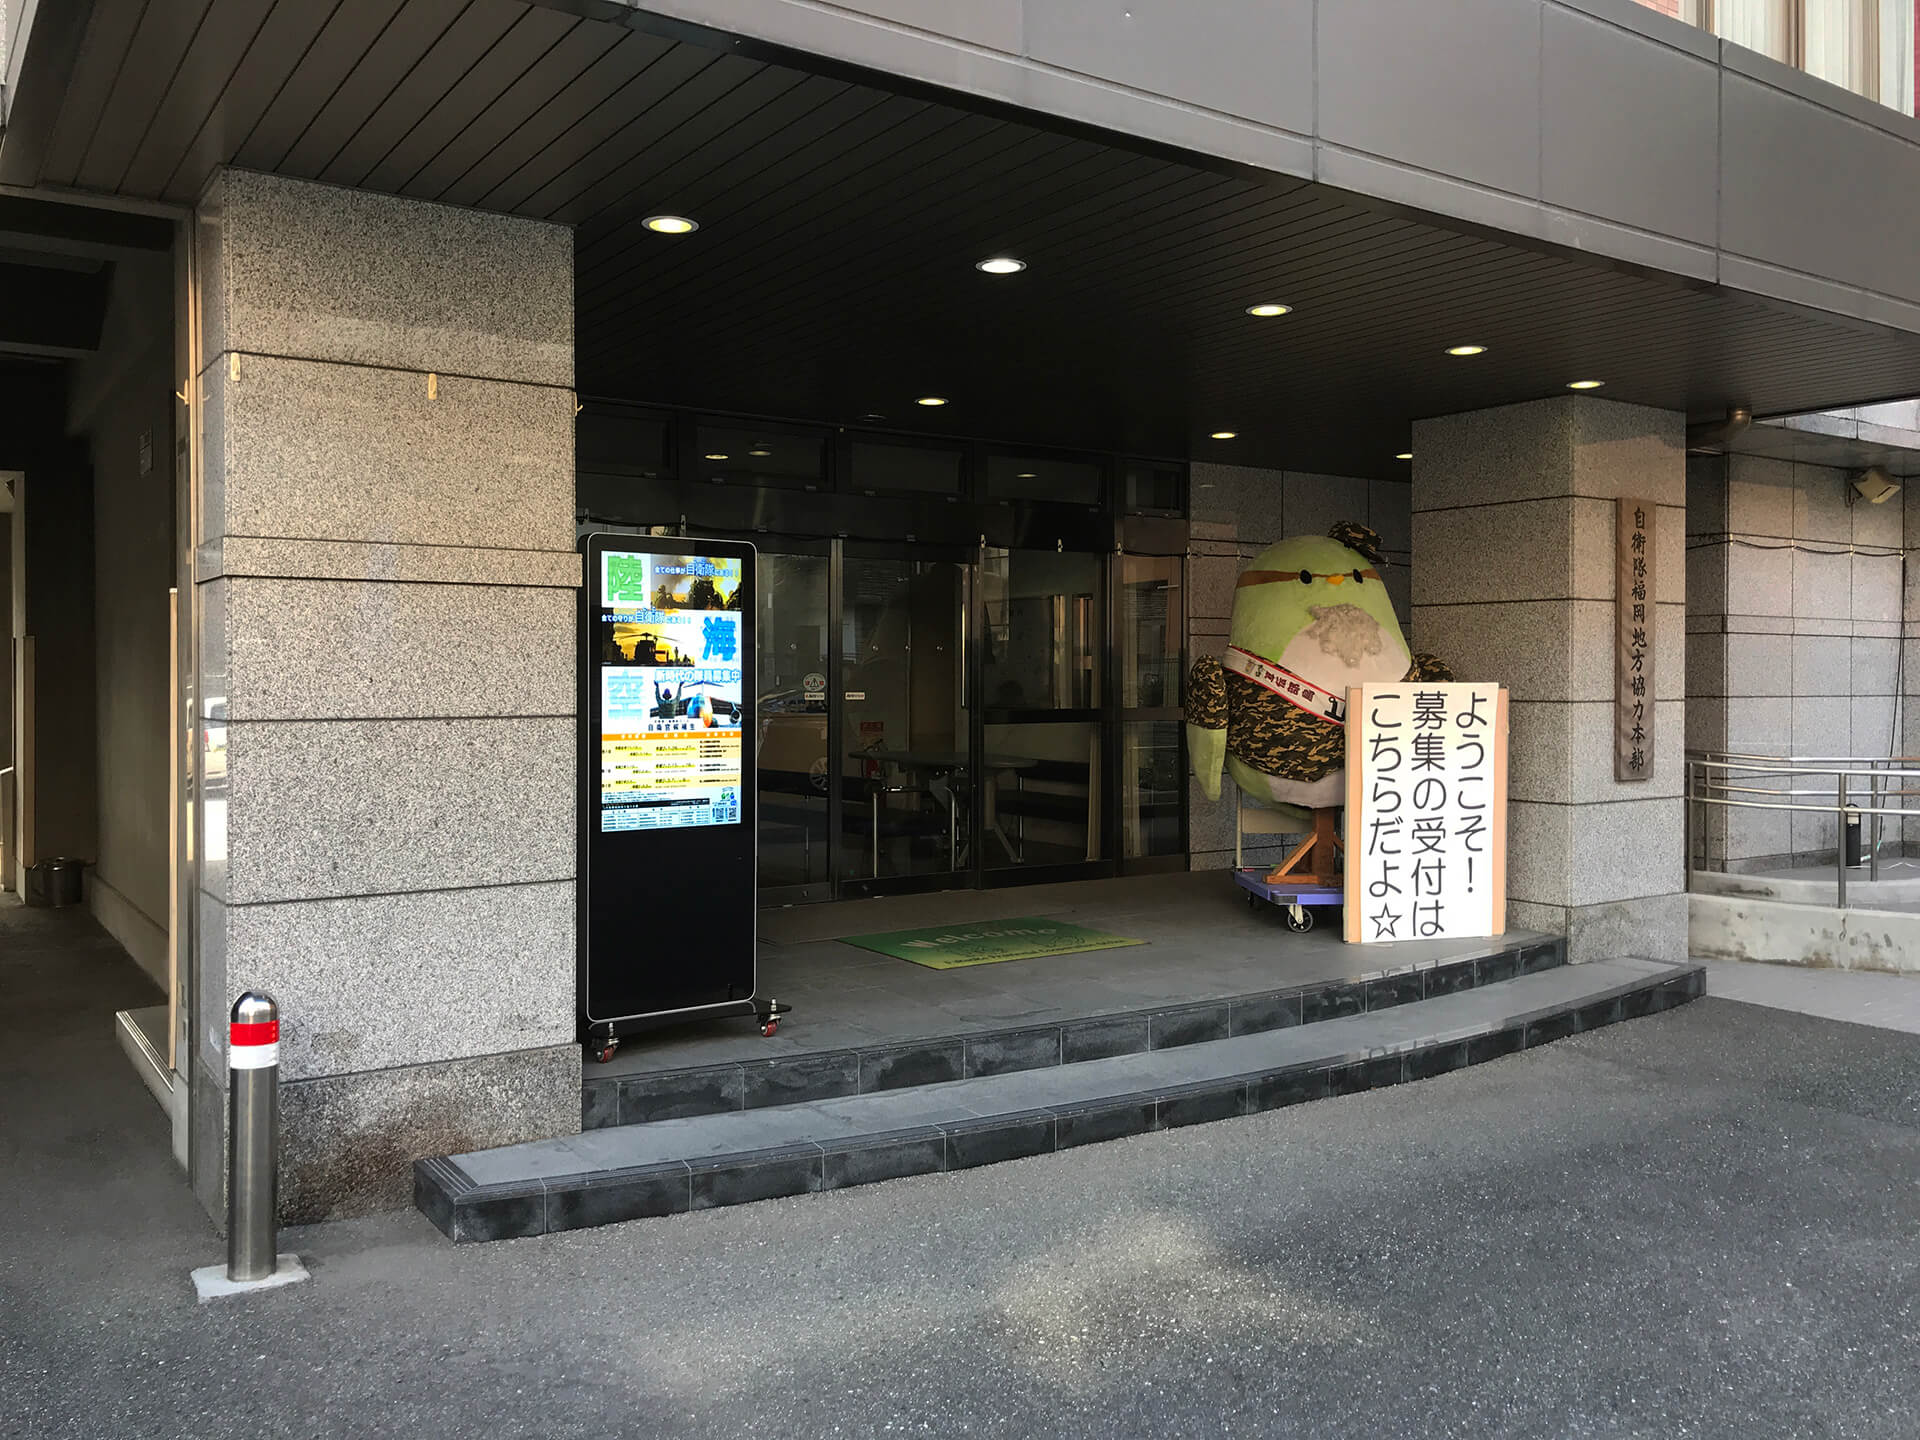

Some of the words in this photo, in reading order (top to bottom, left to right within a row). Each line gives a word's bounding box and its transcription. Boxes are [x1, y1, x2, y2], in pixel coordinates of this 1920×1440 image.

[607, 554, 643, 601] 陸
[702, 616, 737, 661] 海
[1629, 506, 1648, 772] 自衛隊福岡地方協力本部
[607, 669, 643, 720] 空
[1410, 690, 1449, 937] 募集の受付は
[1454, 691, 1488, 893] ようこそ！
[899, 928, 1057, 949] Welcome
